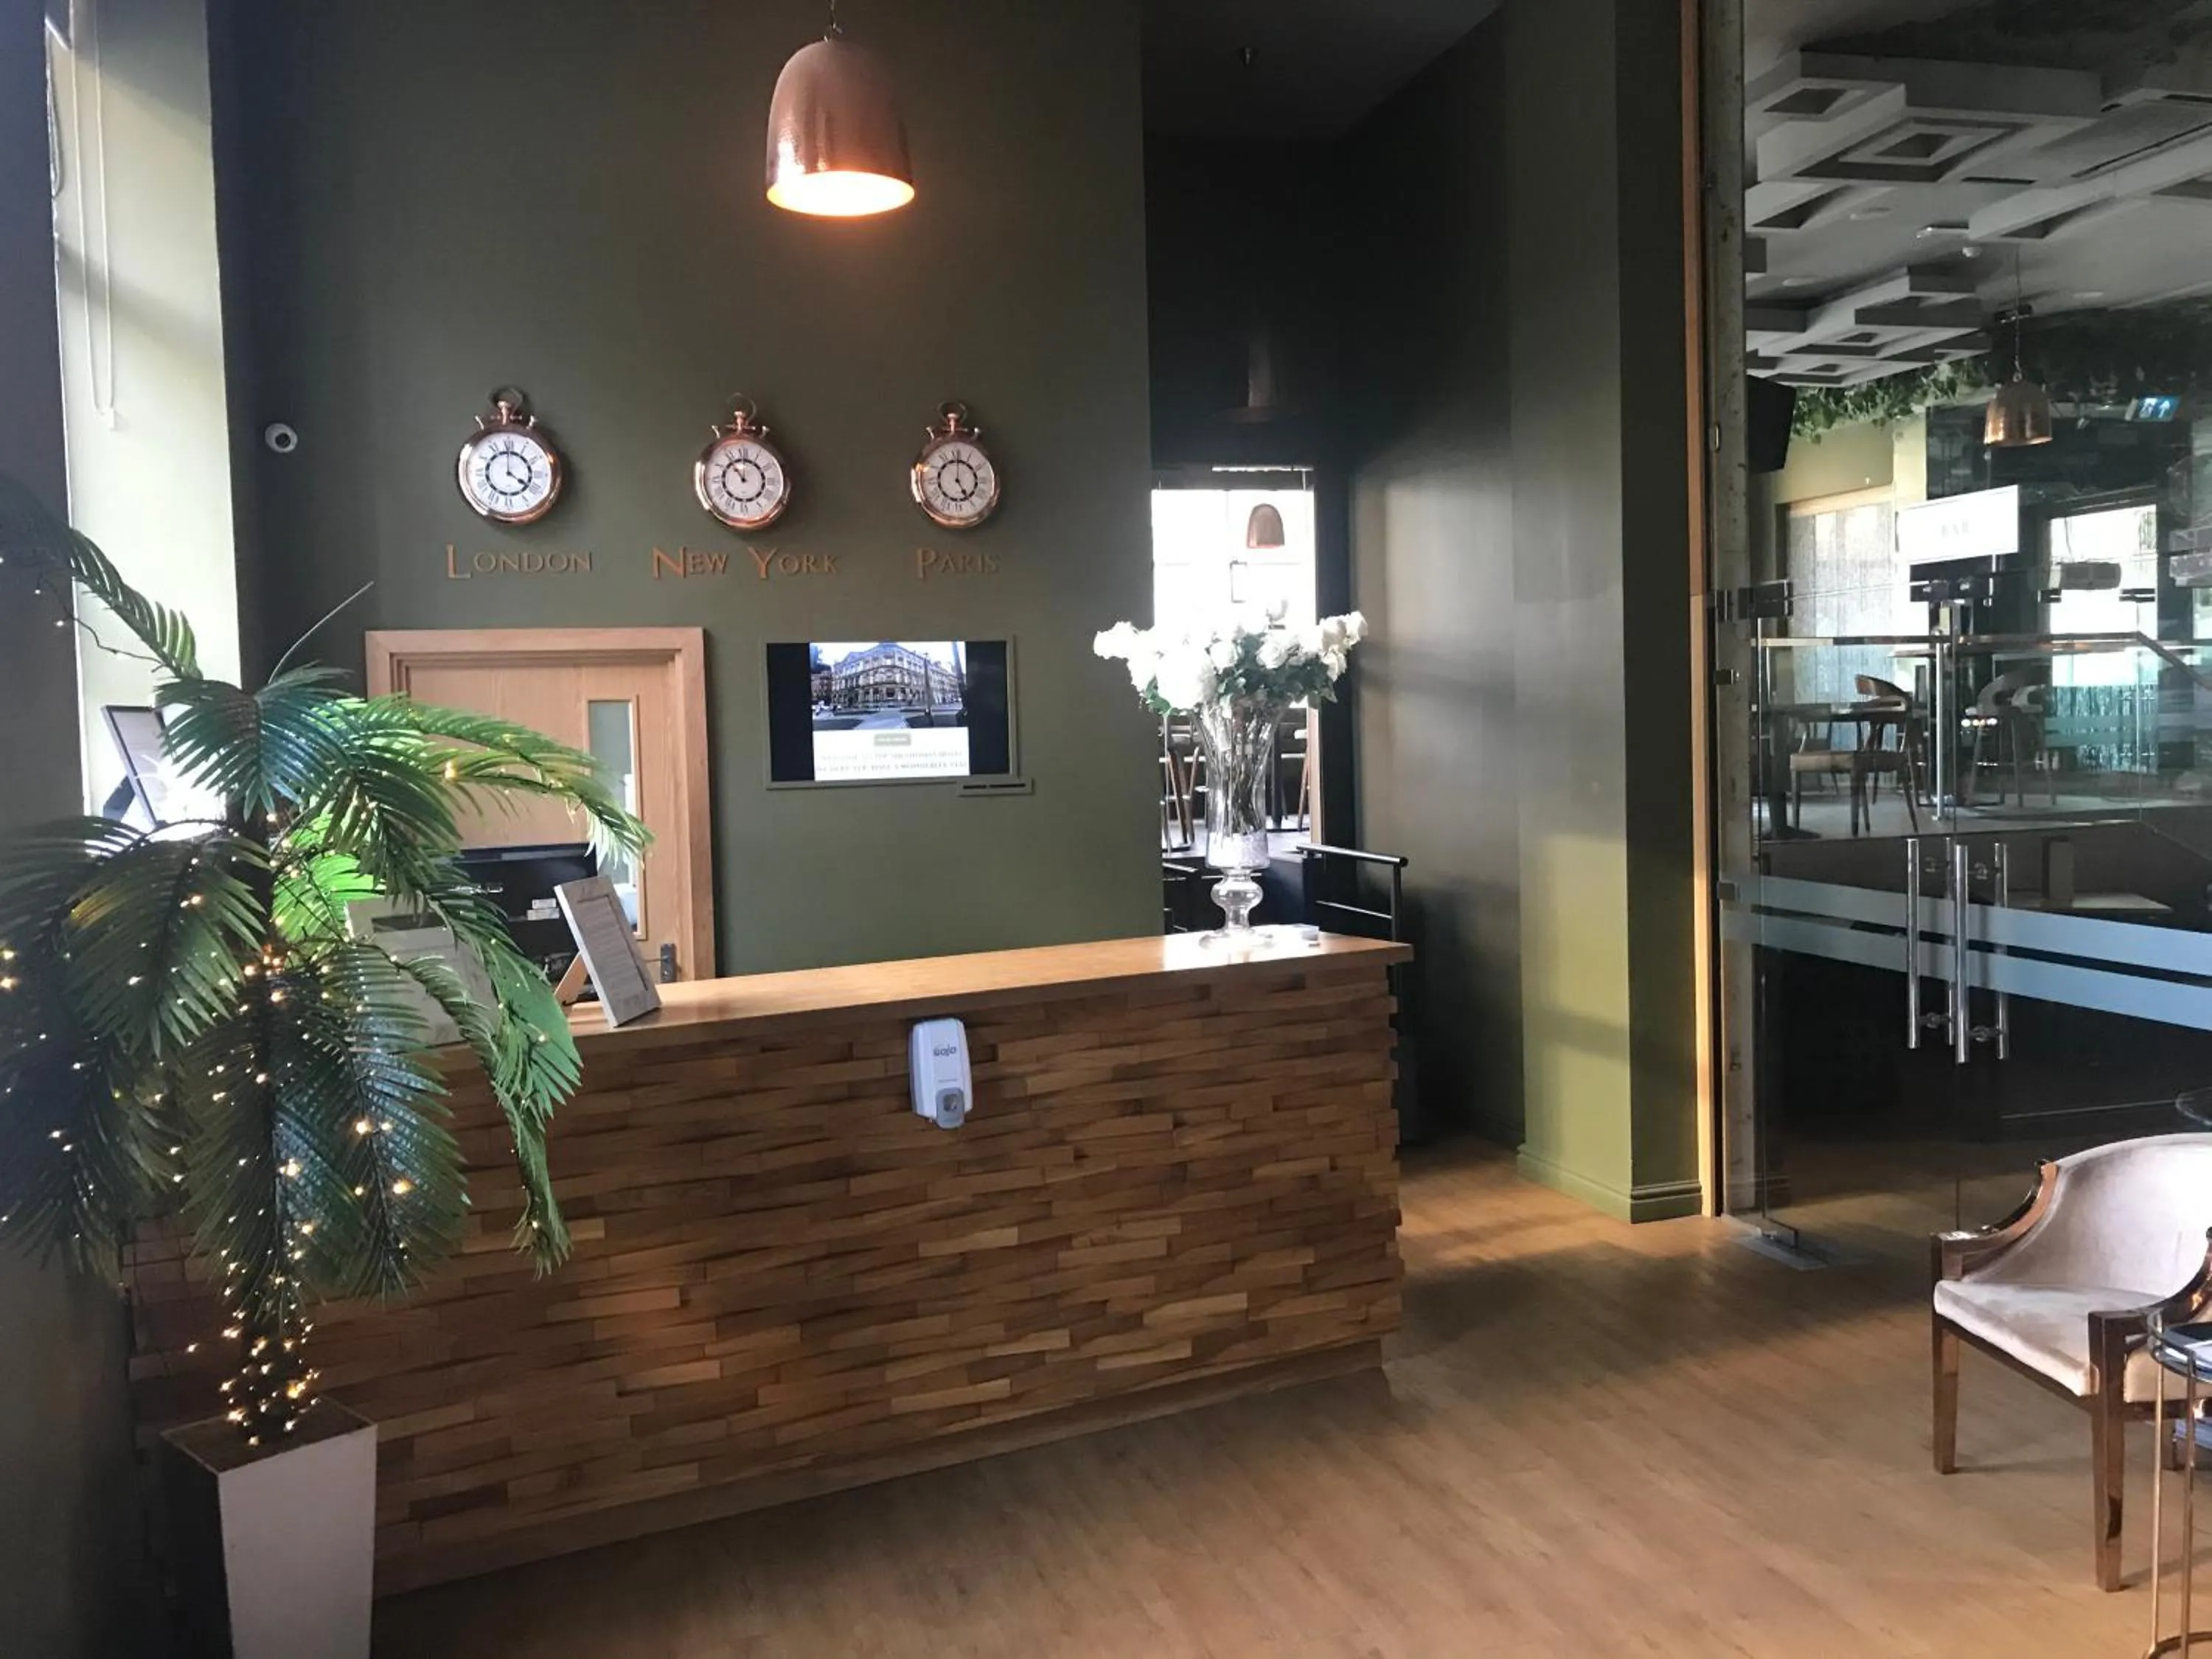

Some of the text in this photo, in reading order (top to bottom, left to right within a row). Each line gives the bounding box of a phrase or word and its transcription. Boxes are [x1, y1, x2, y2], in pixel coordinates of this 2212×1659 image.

[448, 544, 592, 579] LONDON
[652, 546, 838, 579] NEW YORK
[917, 547, 1000, 580] PARIS
